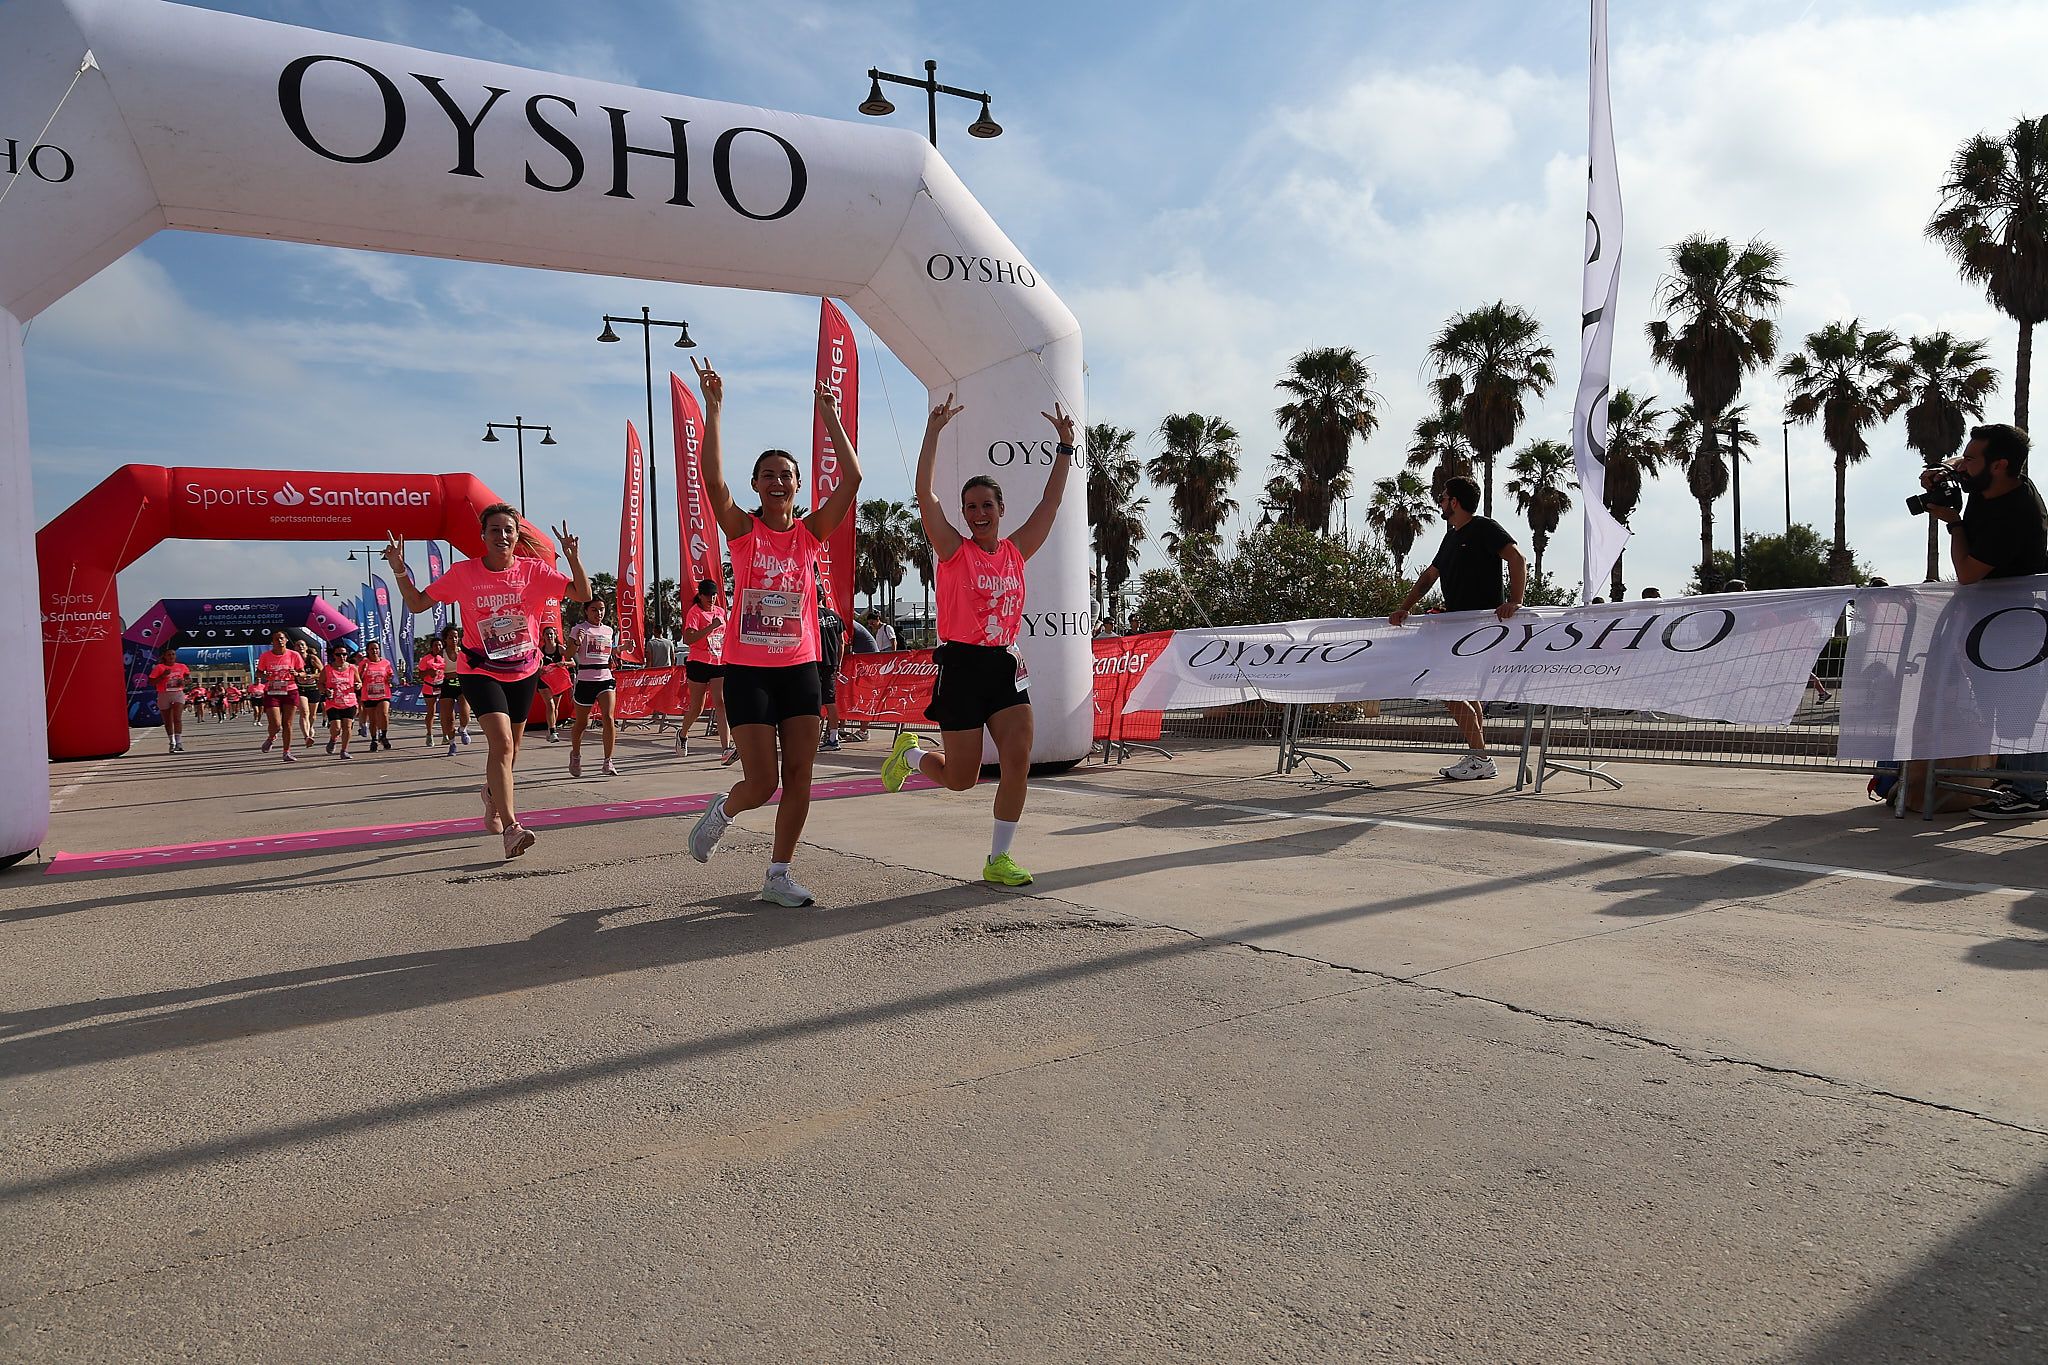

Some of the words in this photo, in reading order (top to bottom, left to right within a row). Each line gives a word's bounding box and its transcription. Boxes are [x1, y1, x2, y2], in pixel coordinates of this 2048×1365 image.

[277, 54, 807, 221] OYSHO
[926, 253, 1036, 288] OYSHO
[988, 440, 1085, 469] OYSO
[186, 483, 269, 510] Sports
[308, 486, 432, 507] Santander
[269, 514, 352, 525] sportssantander.es
[51, 593, 94, 606] Sports
[477, 592, 522, 608] CARRERA
[215, 604, 251, 612] octopus
[251, 603, 280, 612] energy
[50, 611, 112, 622] Santander
[762, 616, 784, 627] 016
[1022, 611, 1091, 638] YSHO
[186, 628, 271, 638] VOLVO
[498, 631, 517, 642] 016
[1451, 609, 1736, 657] OYSHO
[1188, 639, 1373, 668] OYSHO
[1491, 664, 1621, 676] WWW.OYSHO.COM
